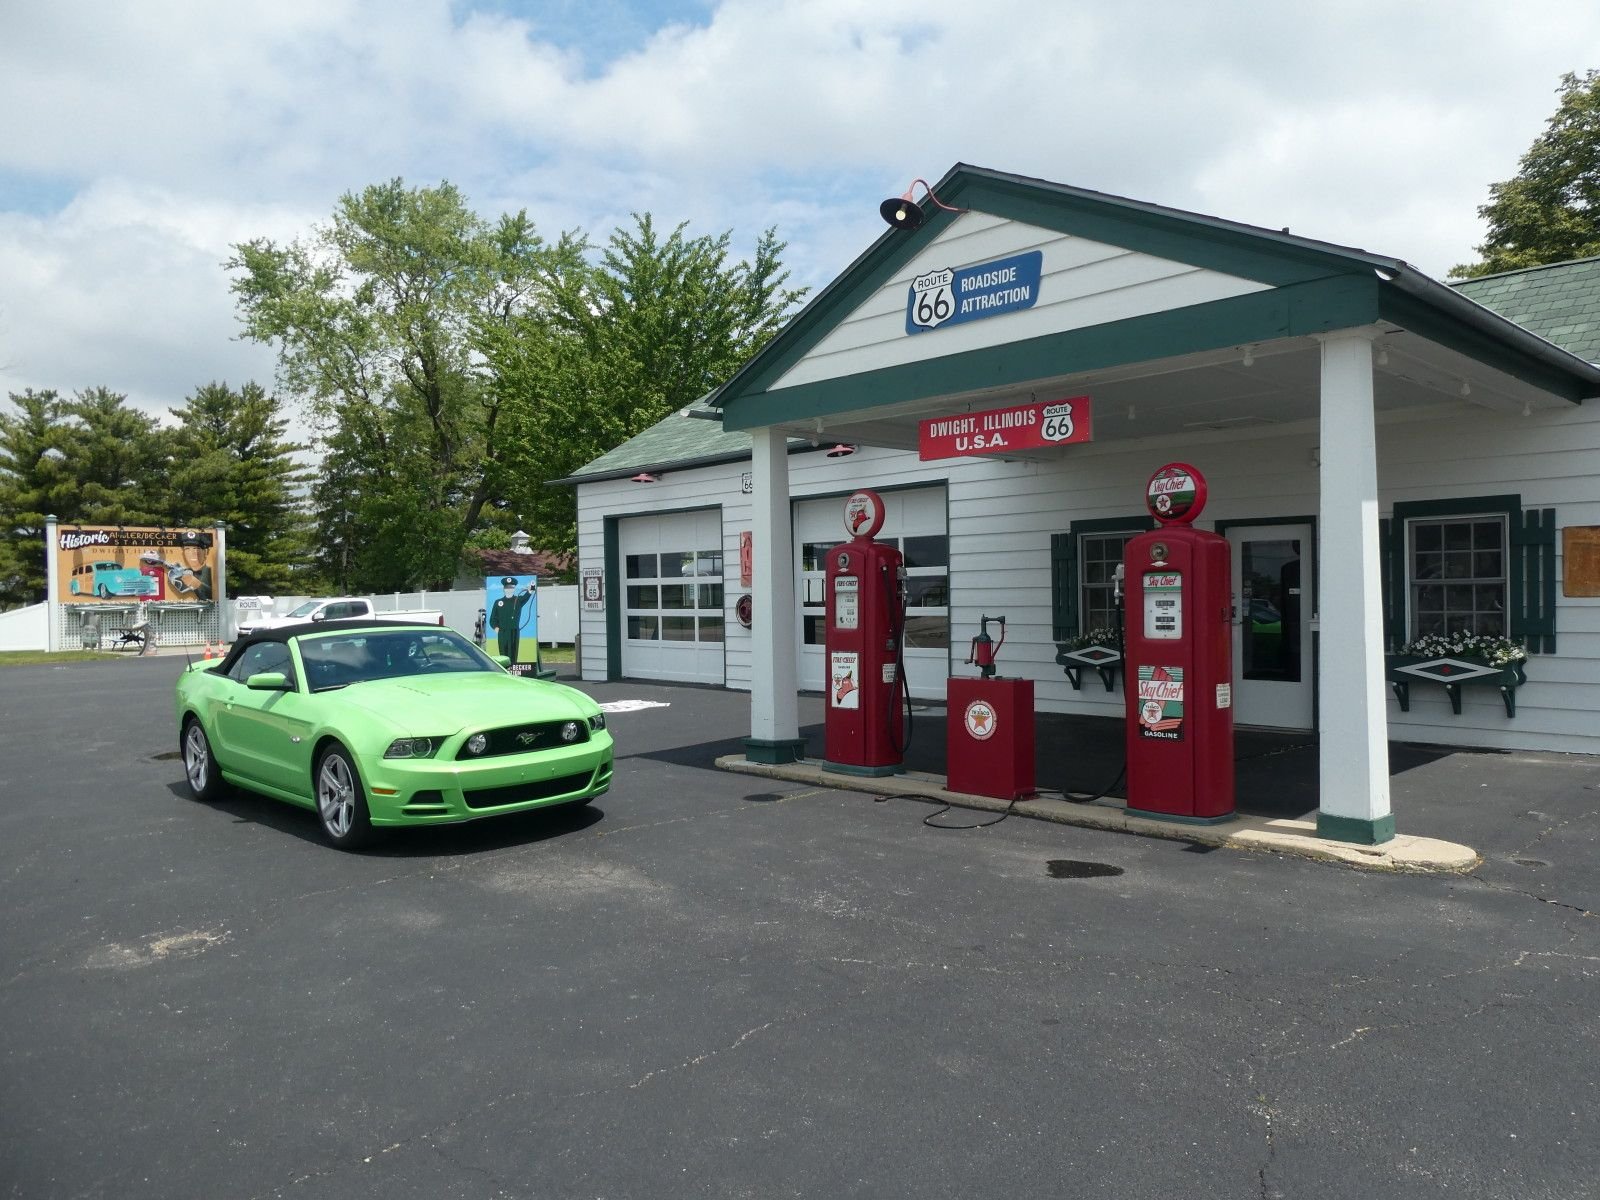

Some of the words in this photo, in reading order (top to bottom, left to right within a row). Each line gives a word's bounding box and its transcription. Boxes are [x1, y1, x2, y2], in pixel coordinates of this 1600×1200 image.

[918, 273, 948, 288] ROUTE
[961, 267, 1016, 292] ROADSIDE
[918, 288, 949, 323] 66
[961, 286, 1030, 314] ATTRACTION
[1046, 405, 1068, 415] ROUTE
[930, 418, 979, 438] DWIGHT,
[984, 409, 1036, 431] ILLINOIS
[1045, 417, 1070, 438] 66
[955, 433, 1008, 451] U.S.A.
[744, 480, 752, 490] 66
[1154, 481, 1165, 493] Sky
[1165, 478, 1187, 491] Chief
[60, 530, 110, 549] Historic
[588, 588, 597, 597] 66
[1139, 681, 1155, 699] Sky
[1156, 681, 1183, 698] Chief
[1144, 731, 1178, 739] GASOLINE
